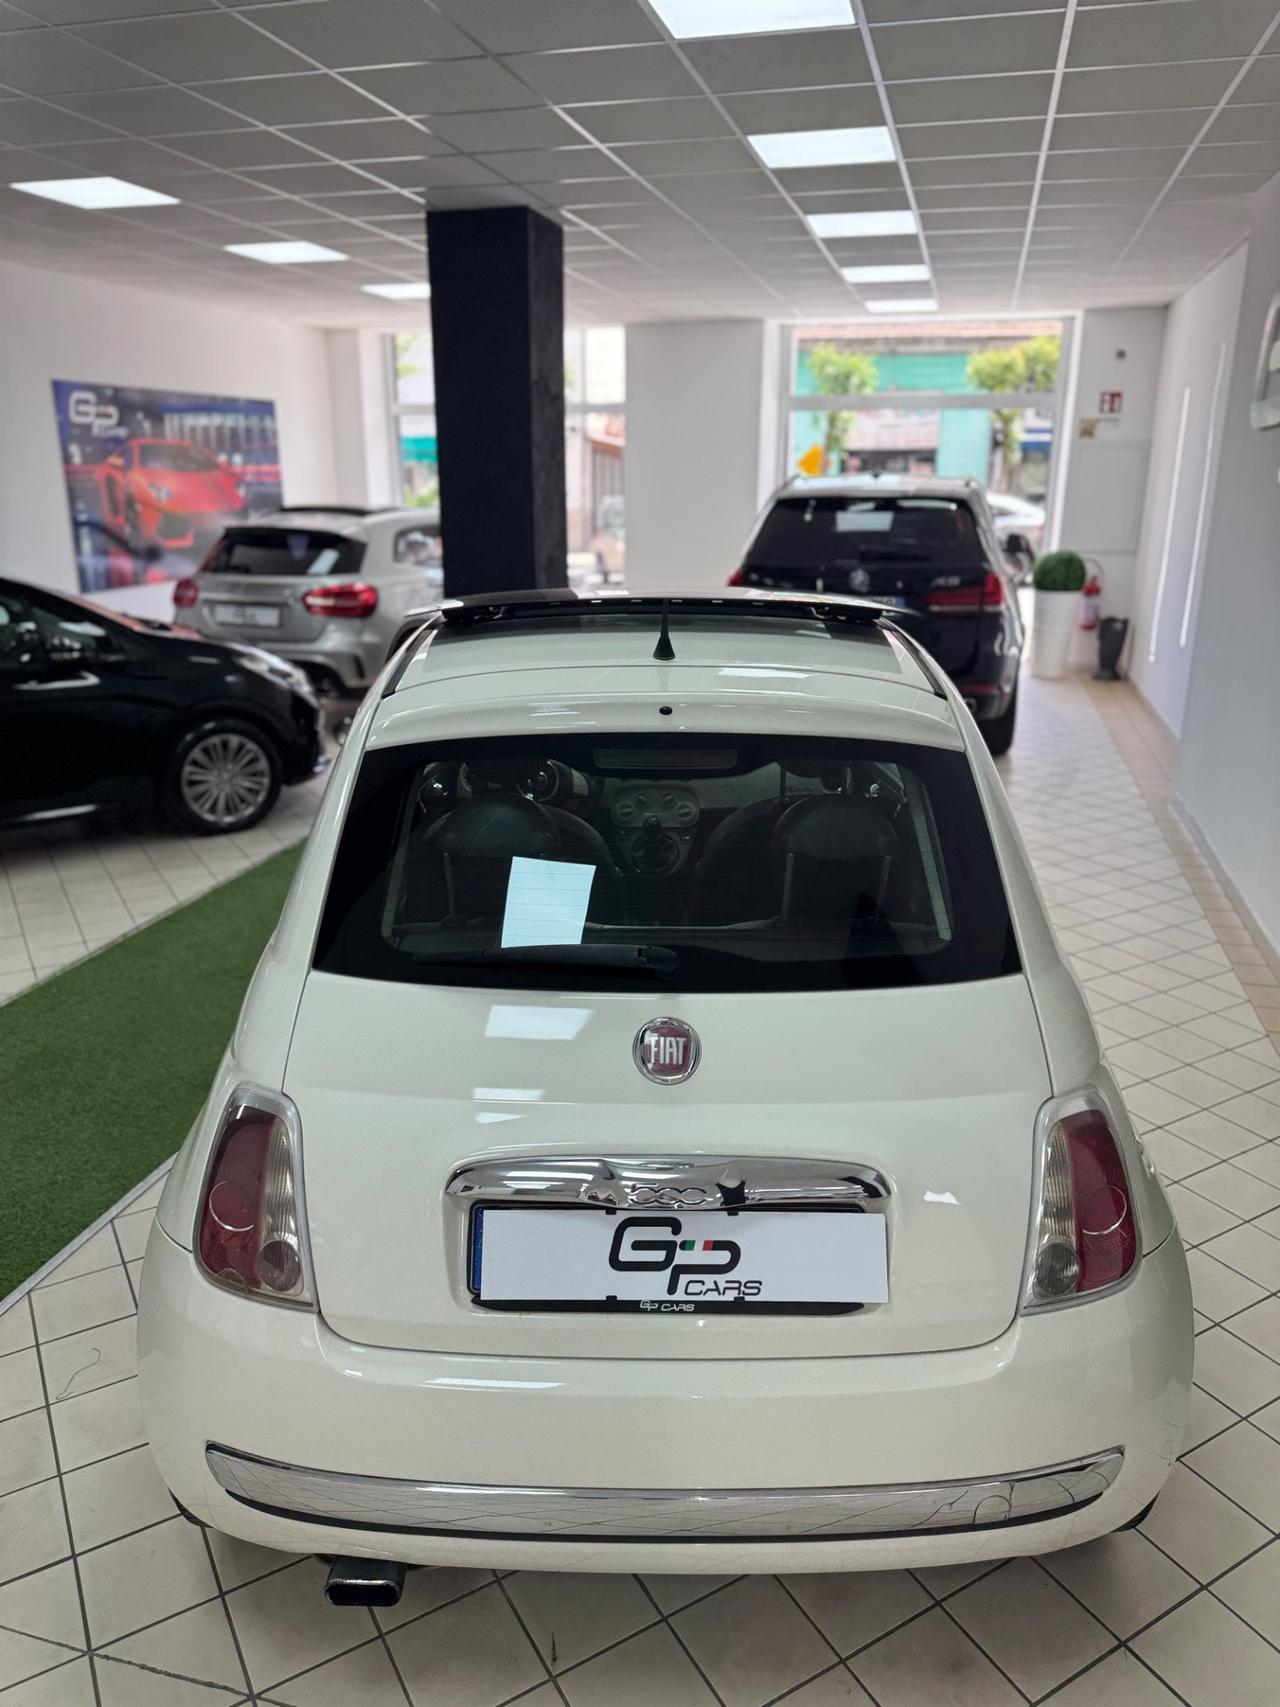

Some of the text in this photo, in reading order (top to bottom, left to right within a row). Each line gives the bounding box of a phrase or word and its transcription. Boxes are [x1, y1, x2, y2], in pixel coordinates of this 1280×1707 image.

[647, 1036, 687, 1064] FIAT
[629, 1182, 708, 1206] 500
[609, 1216, 741, 1295] GP
[684, 1280, 762, 1296] CARS
[640, 1300, 695, 1311] GP CARS
